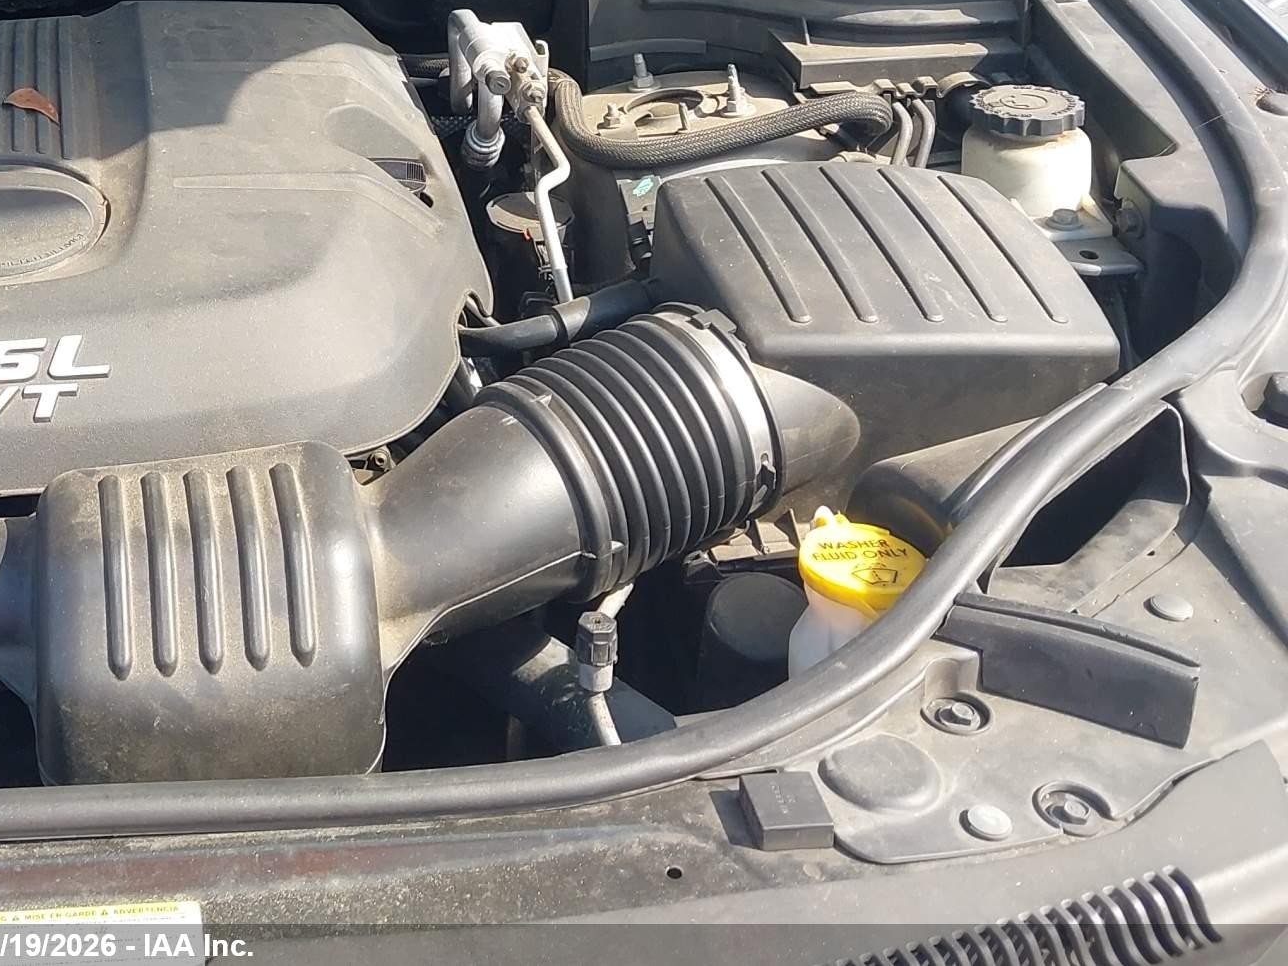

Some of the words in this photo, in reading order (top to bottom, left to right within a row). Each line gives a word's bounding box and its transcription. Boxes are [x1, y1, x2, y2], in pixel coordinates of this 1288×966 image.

[818, 539, 889, 550] WASHER
[812, 552, 858, 561] FLUID
[863, 548, 909, 560] ONLY
